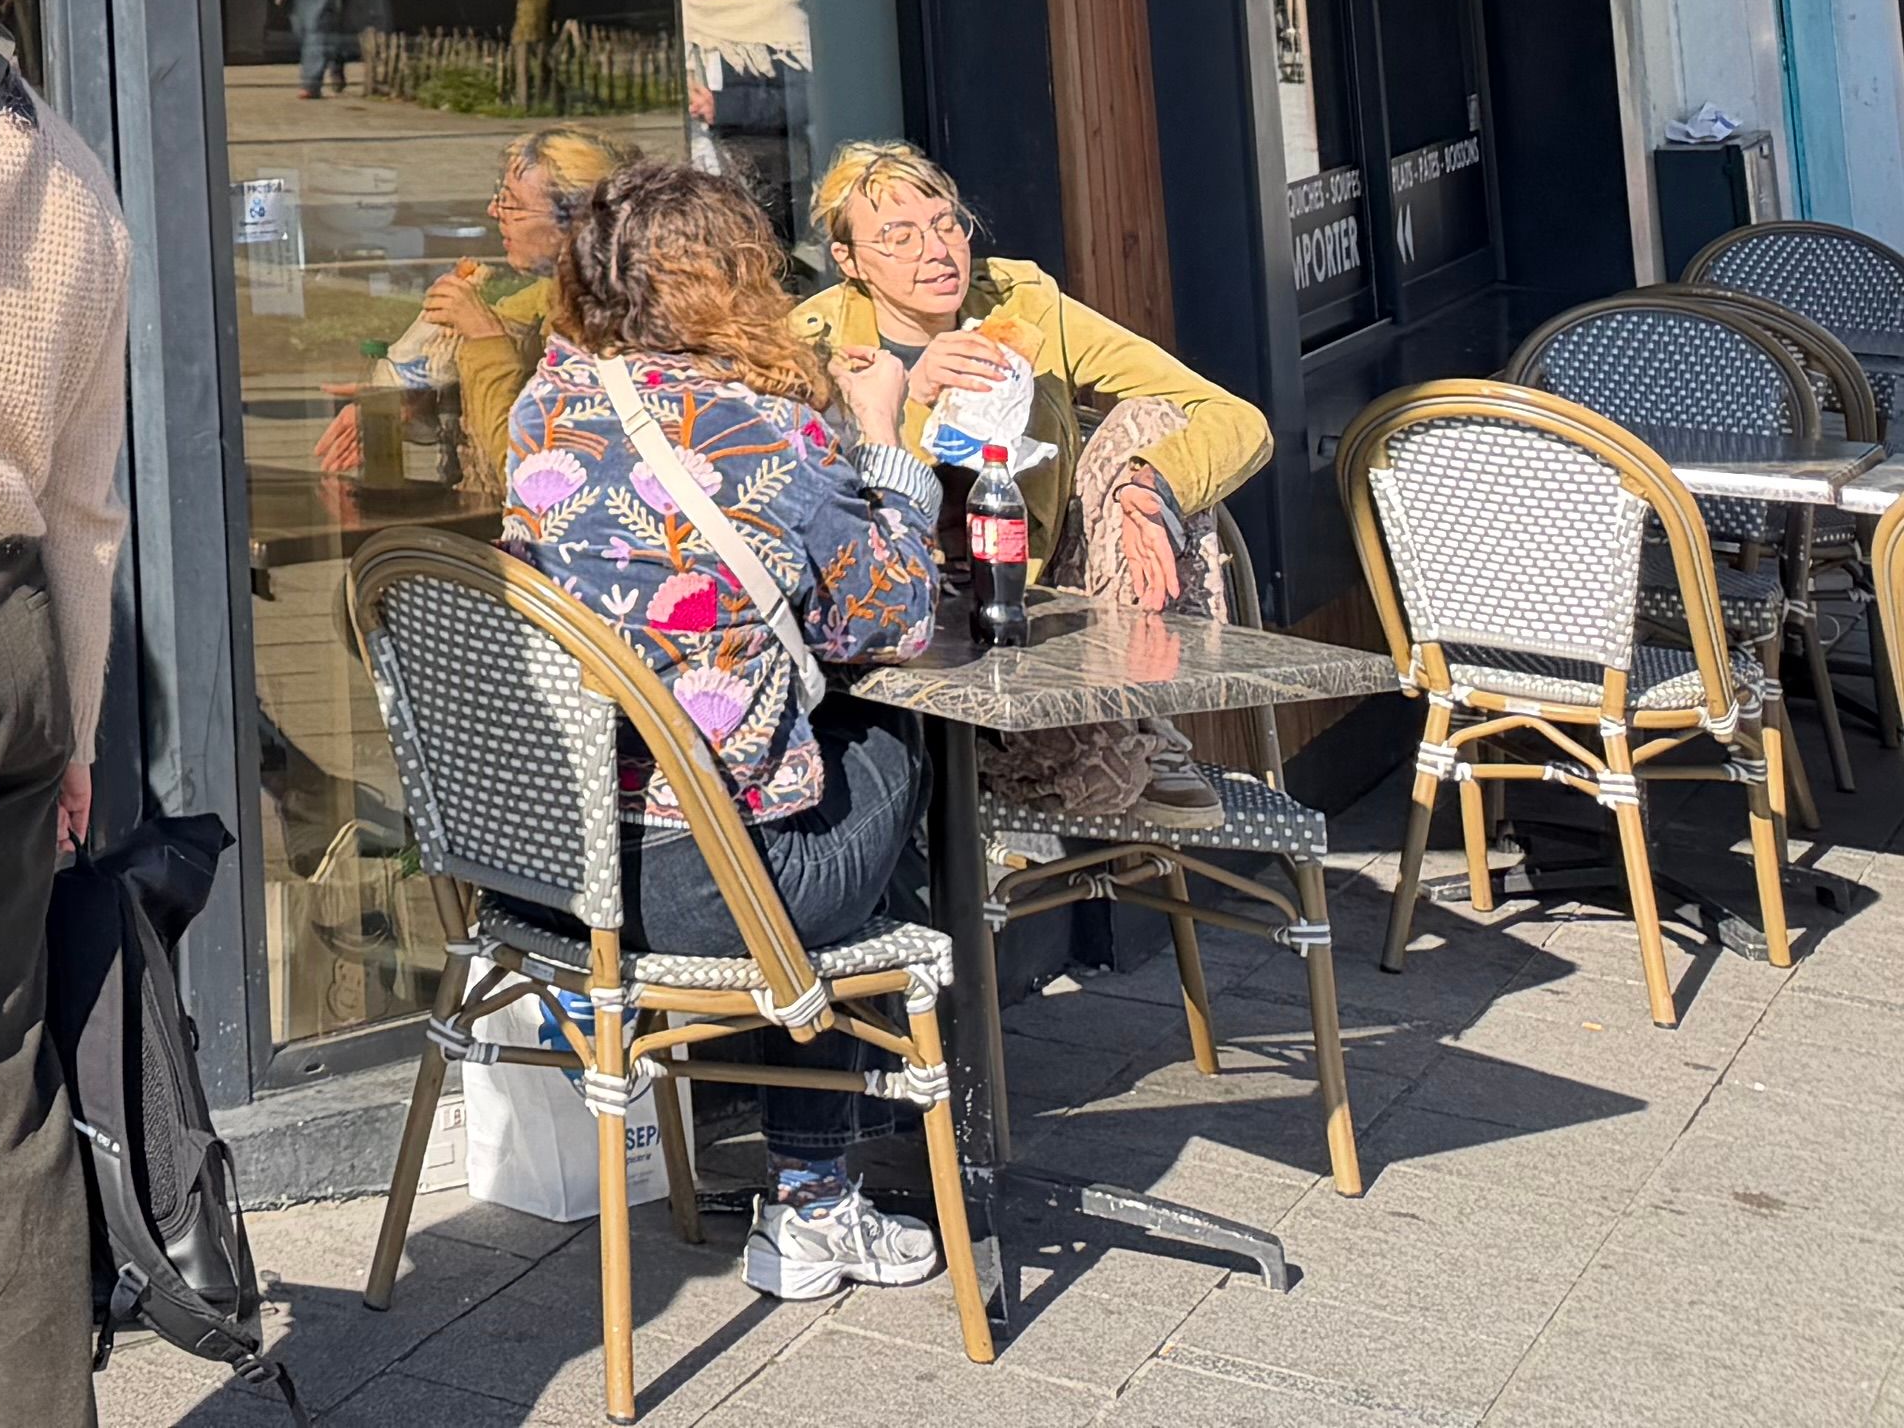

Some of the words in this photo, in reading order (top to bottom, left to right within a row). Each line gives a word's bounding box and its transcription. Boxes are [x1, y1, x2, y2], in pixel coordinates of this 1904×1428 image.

[1391, 161, 1413, 193] PLATS
[1418, 148, 1440, 184] PÂTES
[1444, 136, 1480, 173] BOISSONS
[1287, 180, 1325, 219] QUICHES
[1330, 168, 1362, 205] SOUPES
